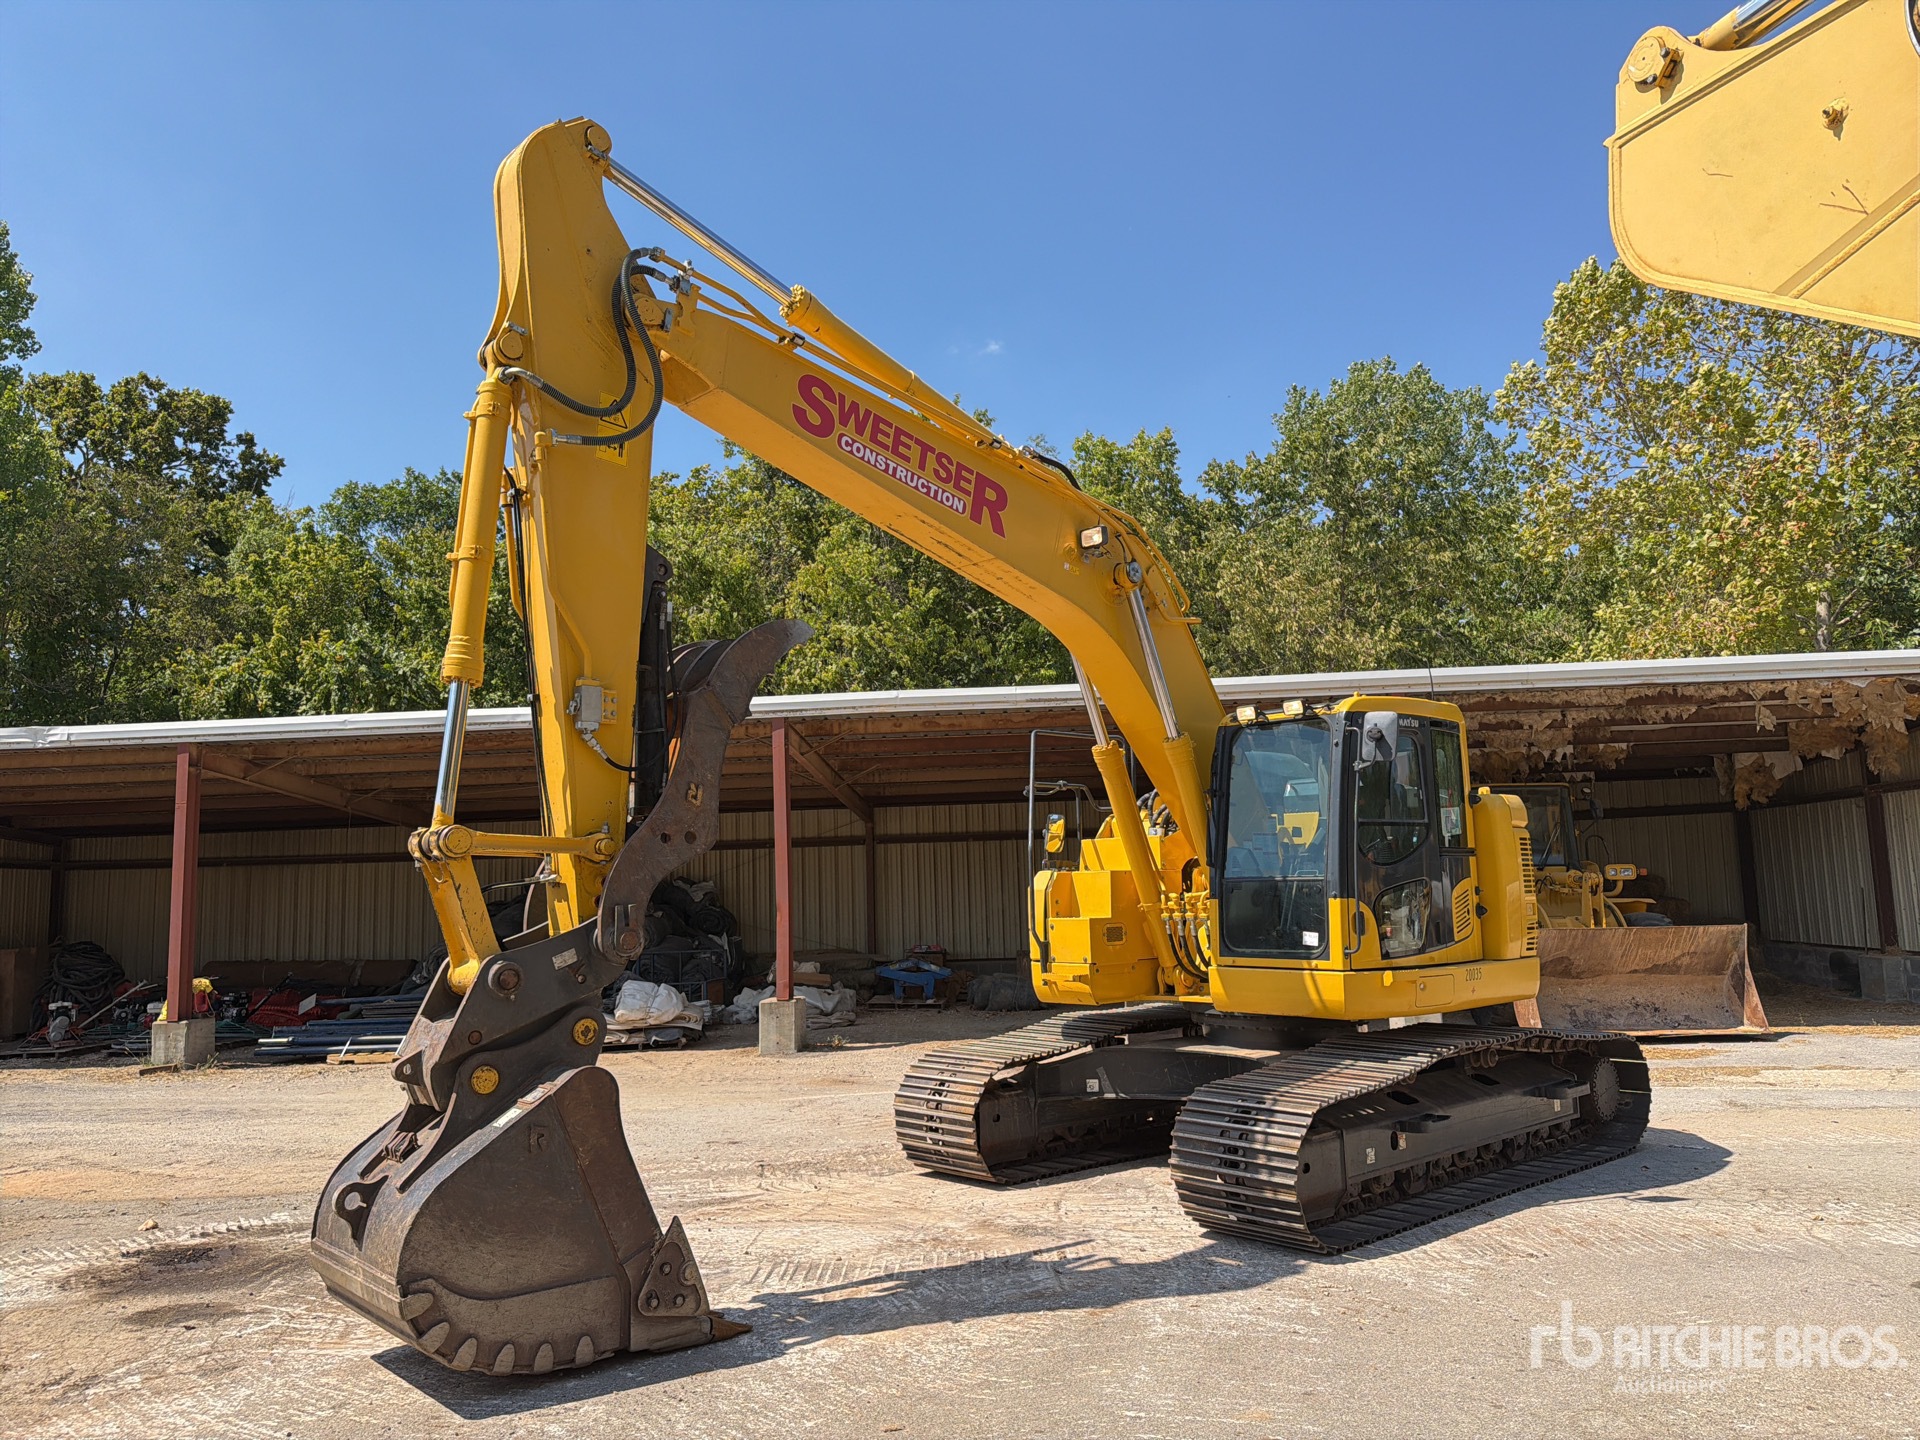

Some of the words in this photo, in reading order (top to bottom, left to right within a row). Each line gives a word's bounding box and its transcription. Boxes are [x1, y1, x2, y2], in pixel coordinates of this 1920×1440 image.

[792, 374, 1008, 538] SWEETSER
[840, 435, 965, 514] CONSTRUCTION
[1399, 717, 1419, 727] MATSU
[1465, 967, 1482, 982] 20035
